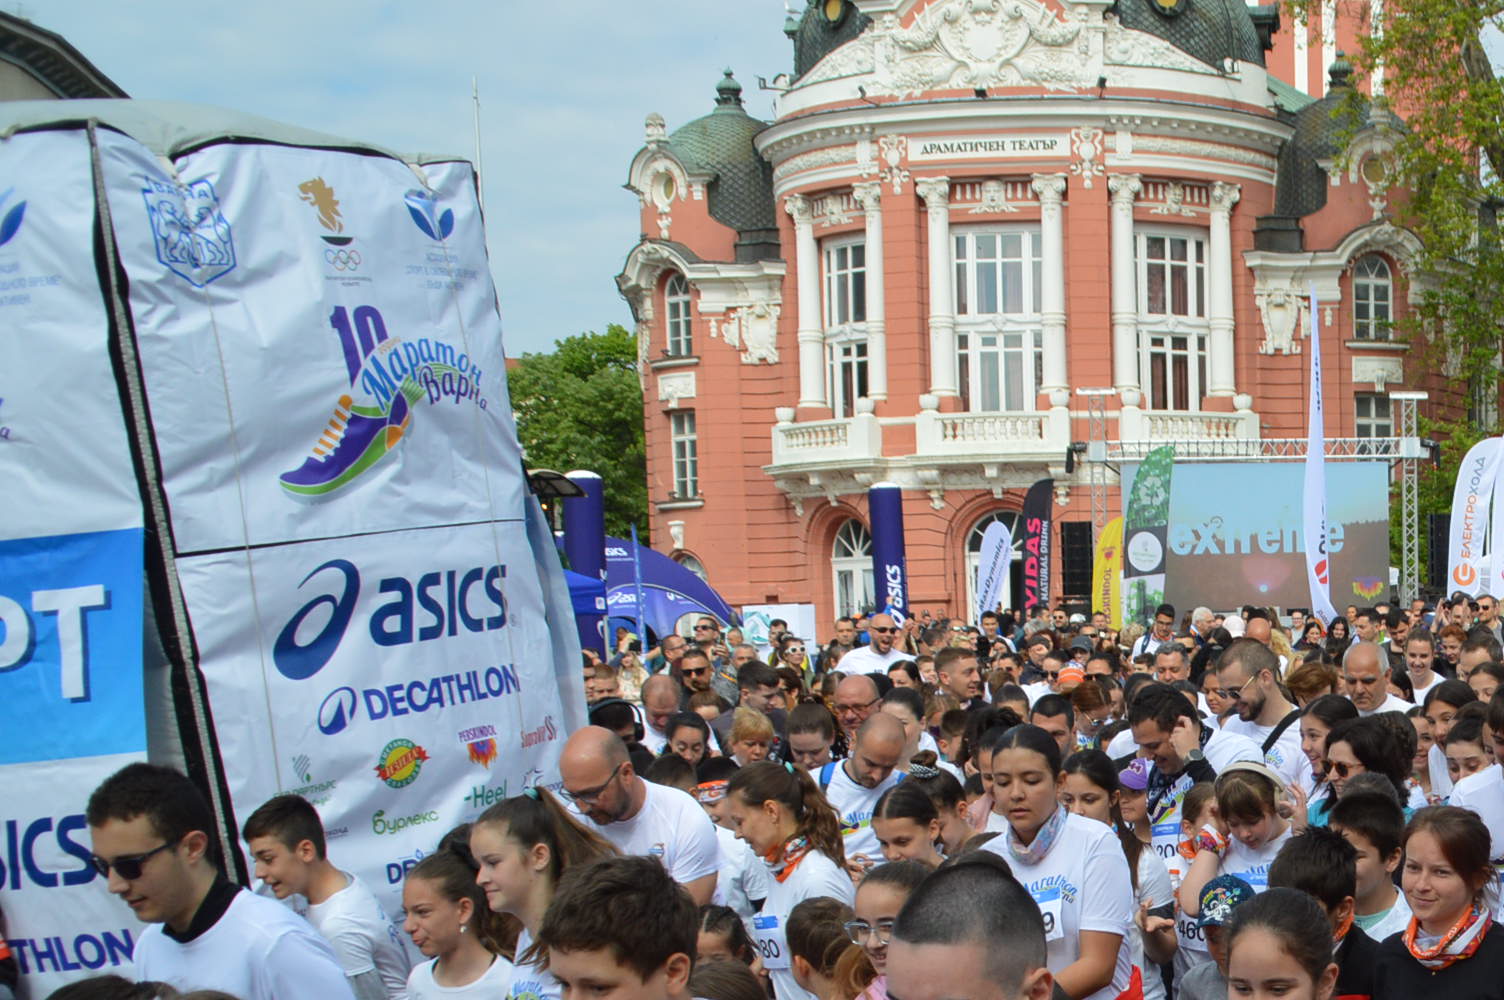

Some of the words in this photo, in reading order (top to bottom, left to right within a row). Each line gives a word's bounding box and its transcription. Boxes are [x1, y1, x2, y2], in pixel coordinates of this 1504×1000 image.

[920, 140, 1005, 156] ДРАМАТИЧЕН
[1010, 139, 1058, 151] ТЕАТЪР
[330, 305, 388, 389] 10
[362, 338, 482, 412] Маратон
[419, 365, 487, 410] Варна
[1040, 551, 1049, 602] NATURAL
[362, 664, 521, 721] DECATHLON
[1024, 874, 1078, 896] arathon
[8, 928, 135, 975] THLON
[761, 939, 780, 959] 80
